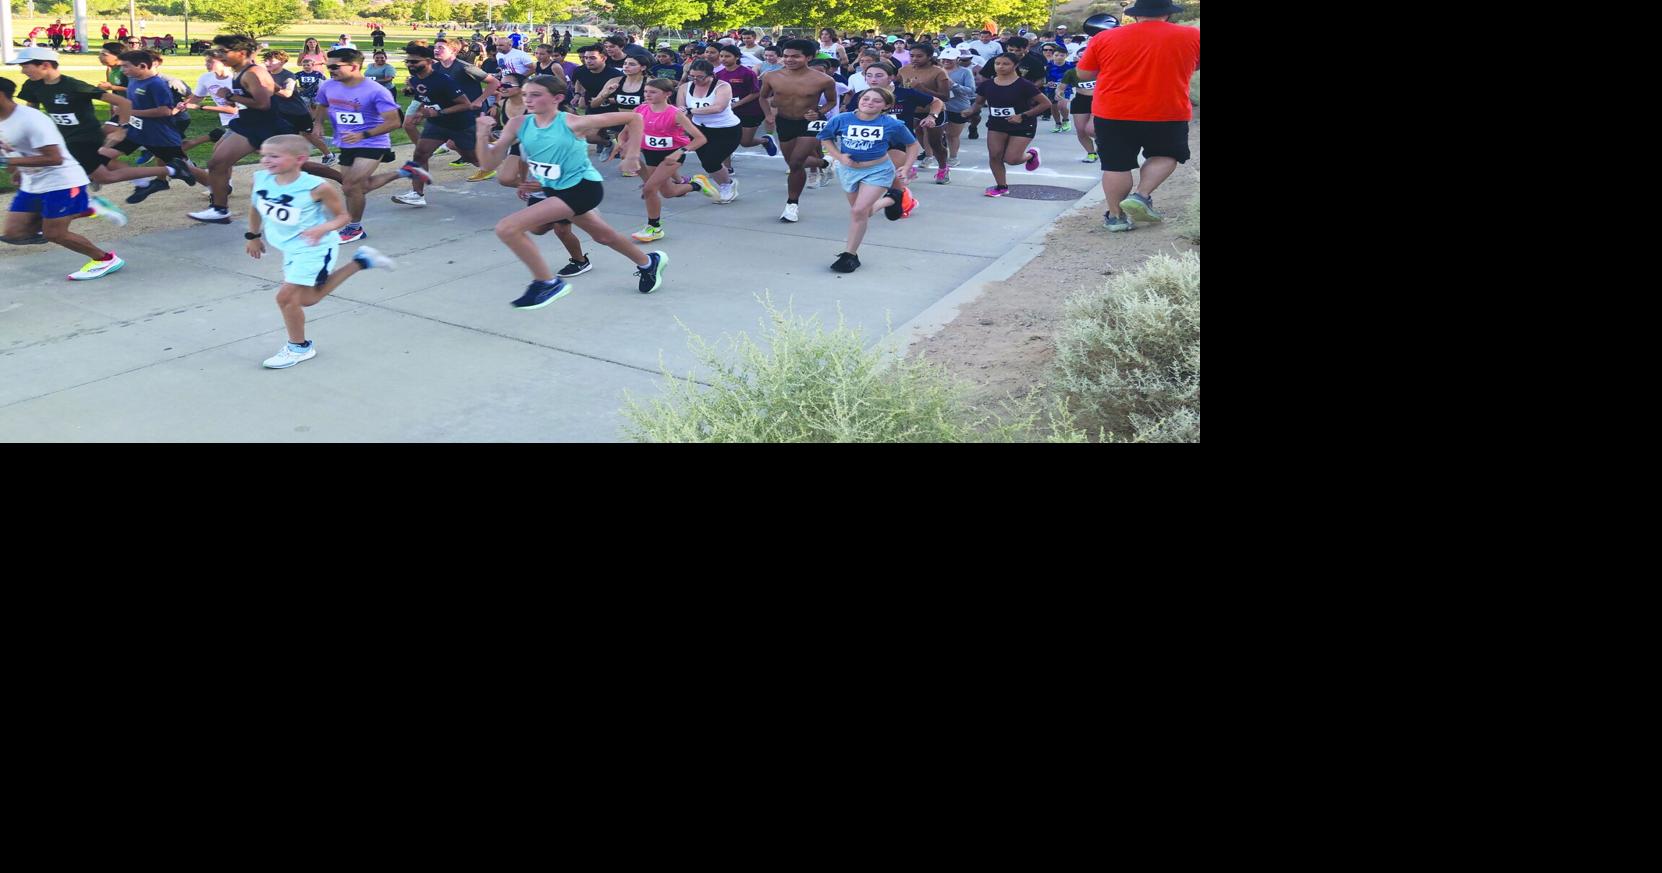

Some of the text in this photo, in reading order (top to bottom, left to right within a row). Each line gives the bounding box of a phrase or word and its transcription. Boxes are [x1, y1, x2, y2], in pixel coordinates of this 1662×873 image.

[620, 96, 636, 105] 26
[994, 108, 1011, 116] 56
[340, 113, 359, 124] 62
[850, 127, 881, 138] 164
[649, 137, 668, 147] 84
[529, 161, 552, 176] 77
[263, 203, 290, 222] 70
